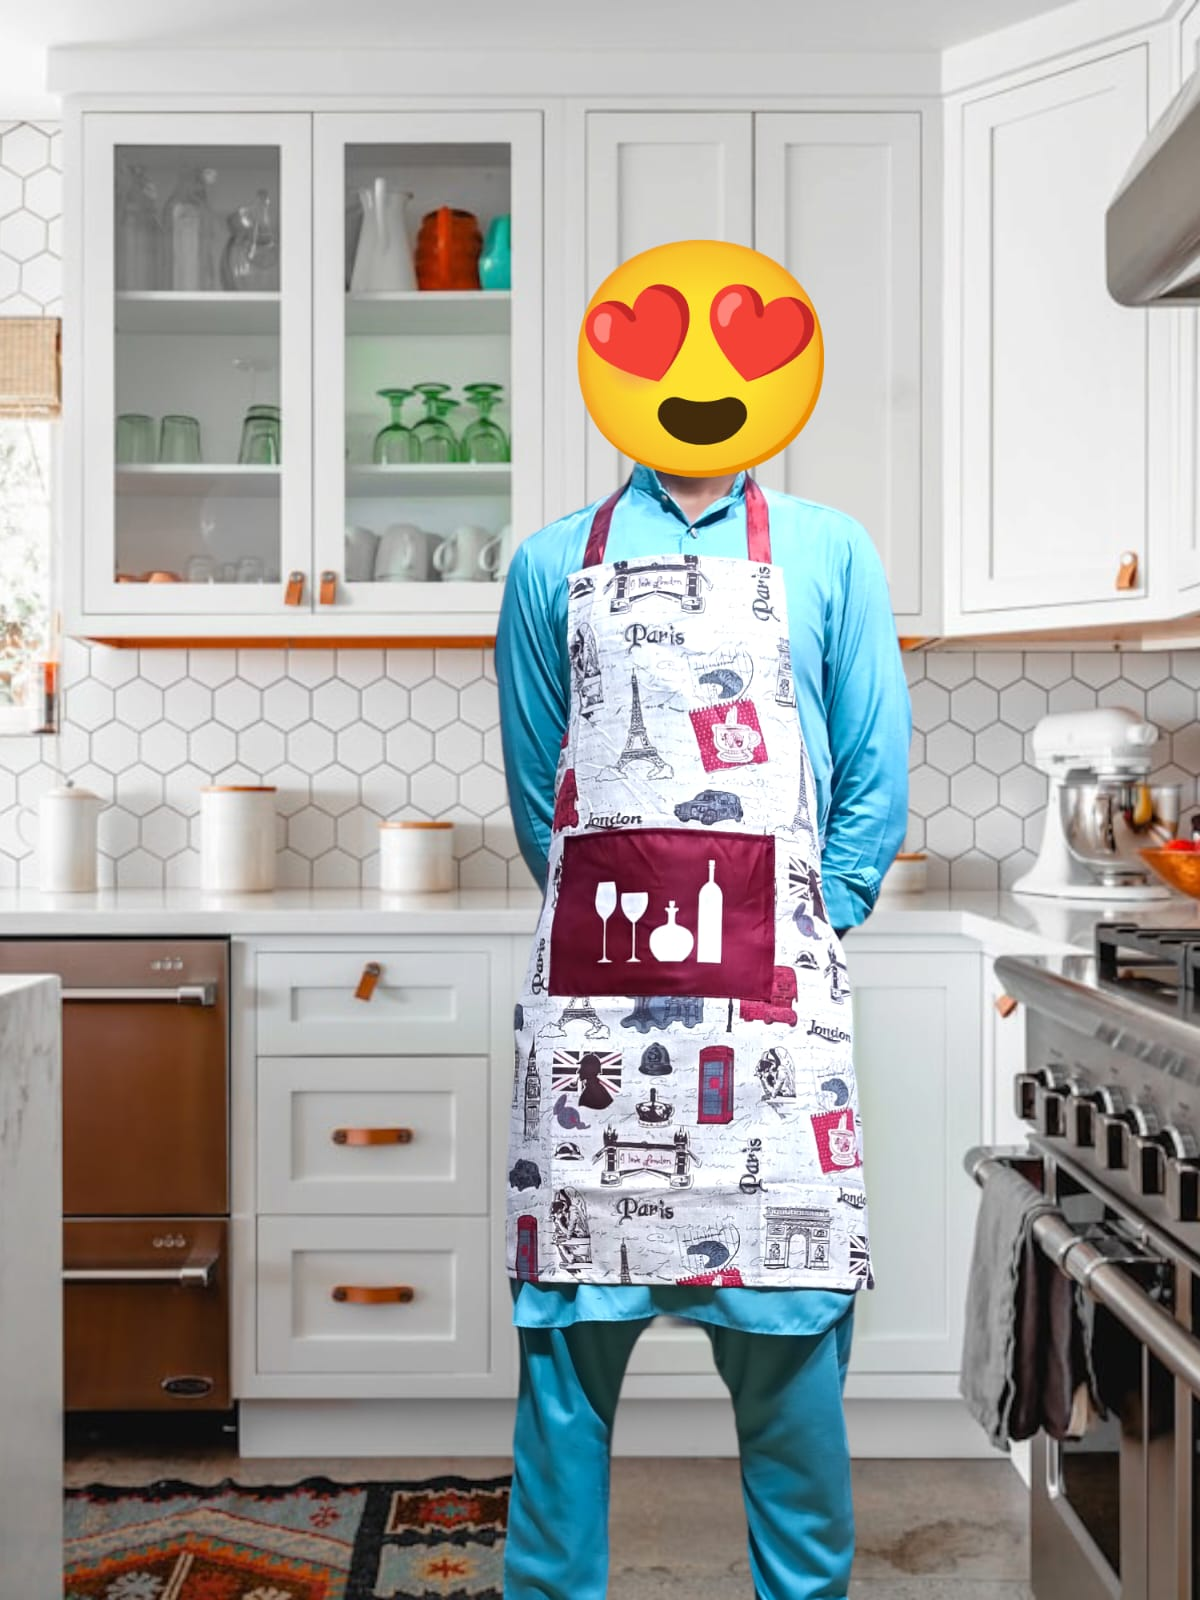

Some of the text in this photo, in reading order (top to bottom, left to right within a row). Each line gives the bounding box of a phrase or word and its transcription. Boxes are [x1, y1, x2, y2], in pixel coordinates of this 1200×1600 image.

[751, 566, 781, 622] Paris
[624, 623, 685, 655] Paris
[584, 812, 642, 831] London
[531, 937, 549, 995] Paris
[806, 1019, 851, 1044] London
[739, 1138, 769, 1195] Paris
[616, 1197, 675, 1226] Paris
